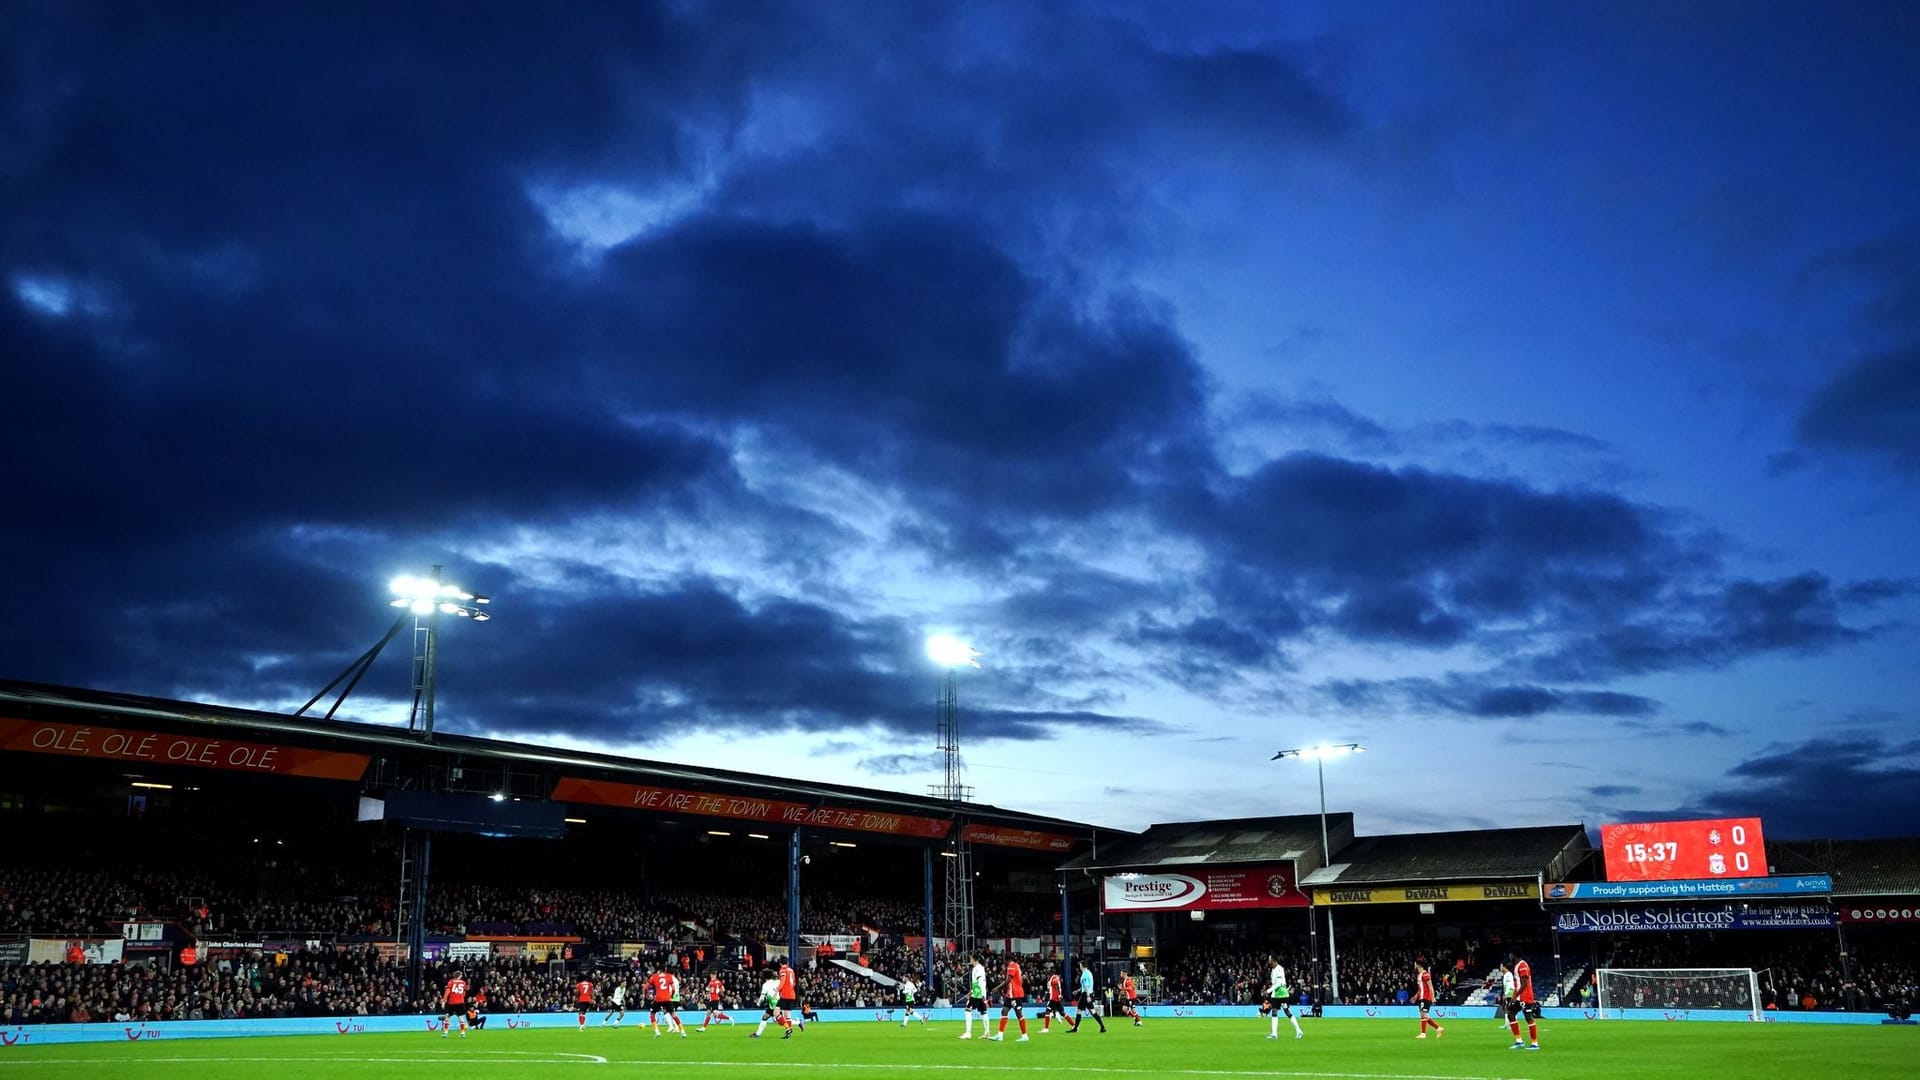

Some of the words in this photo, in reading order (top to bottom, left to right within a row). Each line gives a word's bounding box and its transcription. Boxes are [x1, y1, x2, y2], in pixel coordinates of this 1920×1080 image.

[32, 728, 92, 754] OLÉ,
[102, 734, 158, 760] OLÉ,
[167, 740, 220, 766] OLÉ,
[228, 746, 279, 771] OLÉ,
[633, 789, 662, 807] WE
[660, 794, 696, 810] ARE
[695, 796, 727, 813] THE
[726, 799, 771, 817] TOWN
[782, 806, 807, 821] WE
[805, 809, 835, 824] ARE
[834, 811, 860, 826] THE
[1731, 825, 1745, 846] 0
[1624, 841, 1678, 863] 15:37
[1735, 851, 1749, 872] 0
[1125, 881, 1172, 894] Prestige
[1593, 886, 1626, 896] Proudly
[1628, 885, 1679, 895] supporting
[1679, 884, 1696, 892] the
[1697, 882, 1736, 892] Hatters
[1581, 909, 1640, 926] Noble
[1644, 907, 1735, 925] Solicitors
[451, 983, 464, 995] 45
[582, 984, 588, 994] 7
[659, 978, 668, 990] 2
[146, 1030, 161, 1038] TUI
